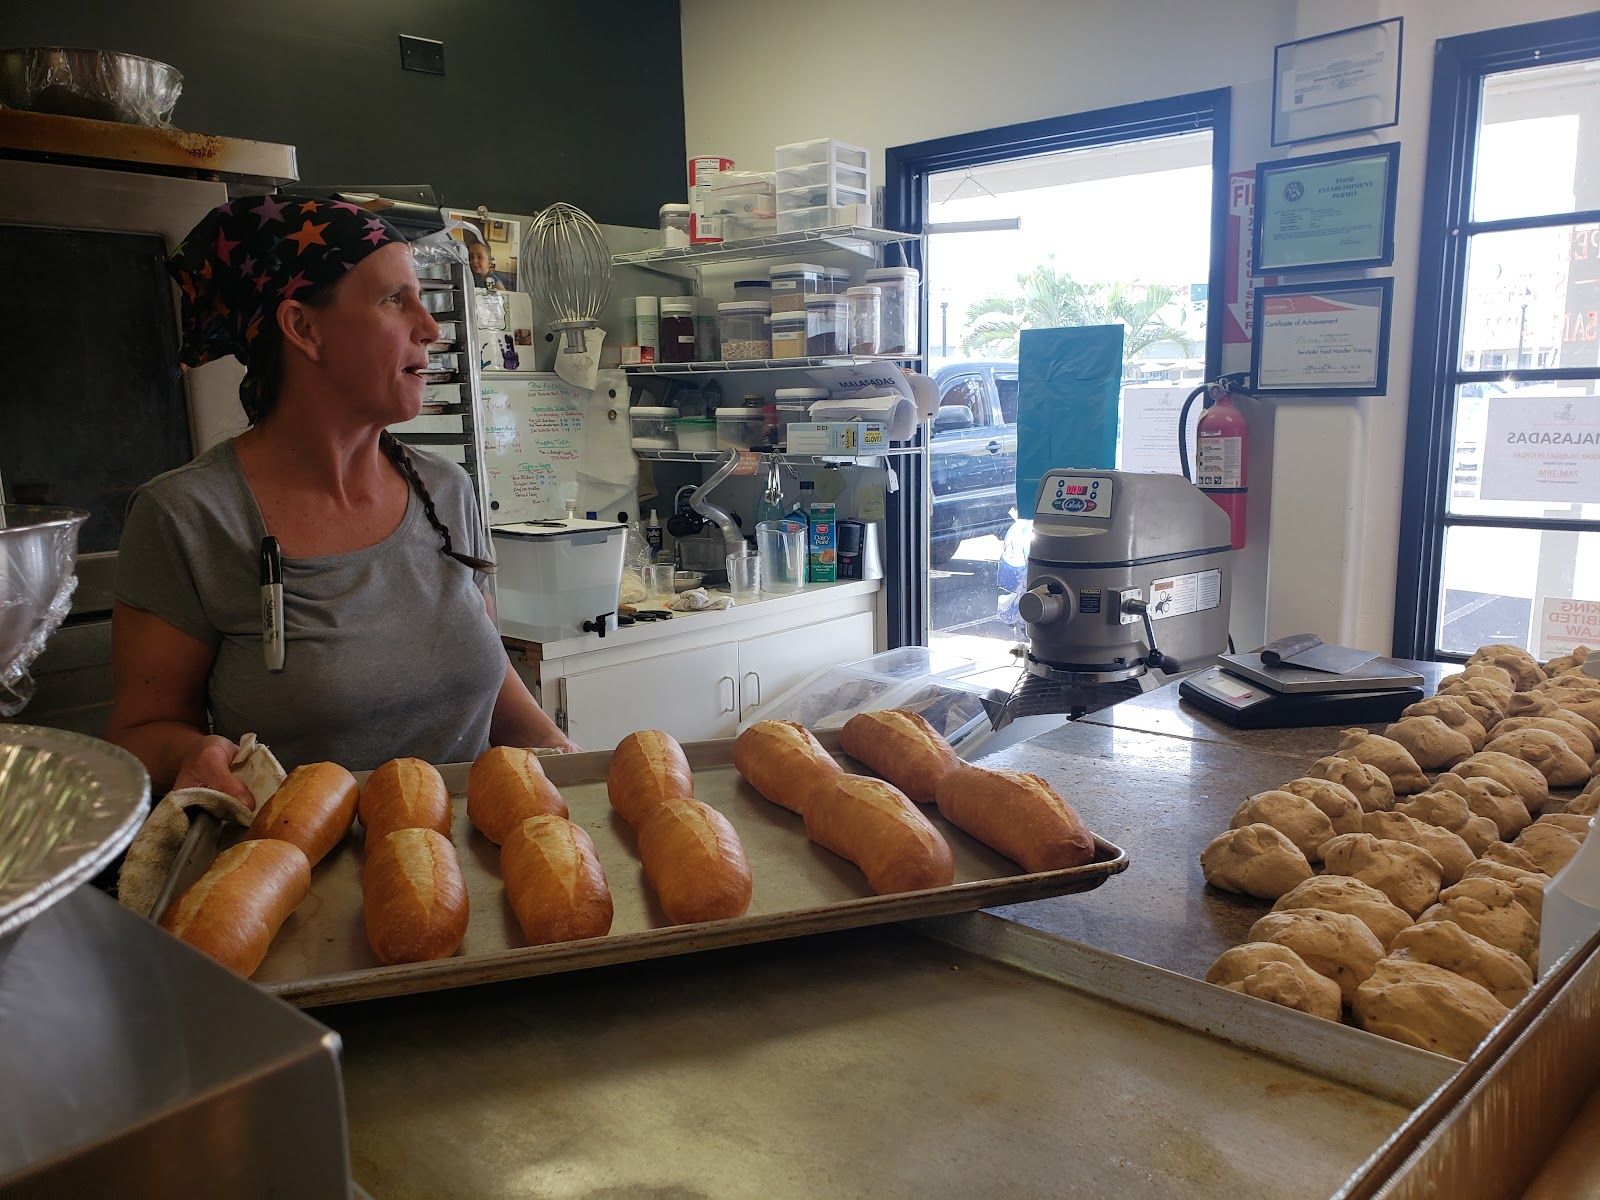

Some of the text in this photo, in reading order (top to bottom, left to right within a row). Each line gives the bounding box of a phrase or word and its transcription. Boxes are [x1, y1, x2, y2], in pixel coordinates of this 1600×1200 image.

[1318, 181, 1373, 193] ESTABLISHMENT
[1332, 191, 1357, 199] PERMIT
[1301, 318, 1338, 326] Achievement
[838, 377, 896, 389] MALASADAS
